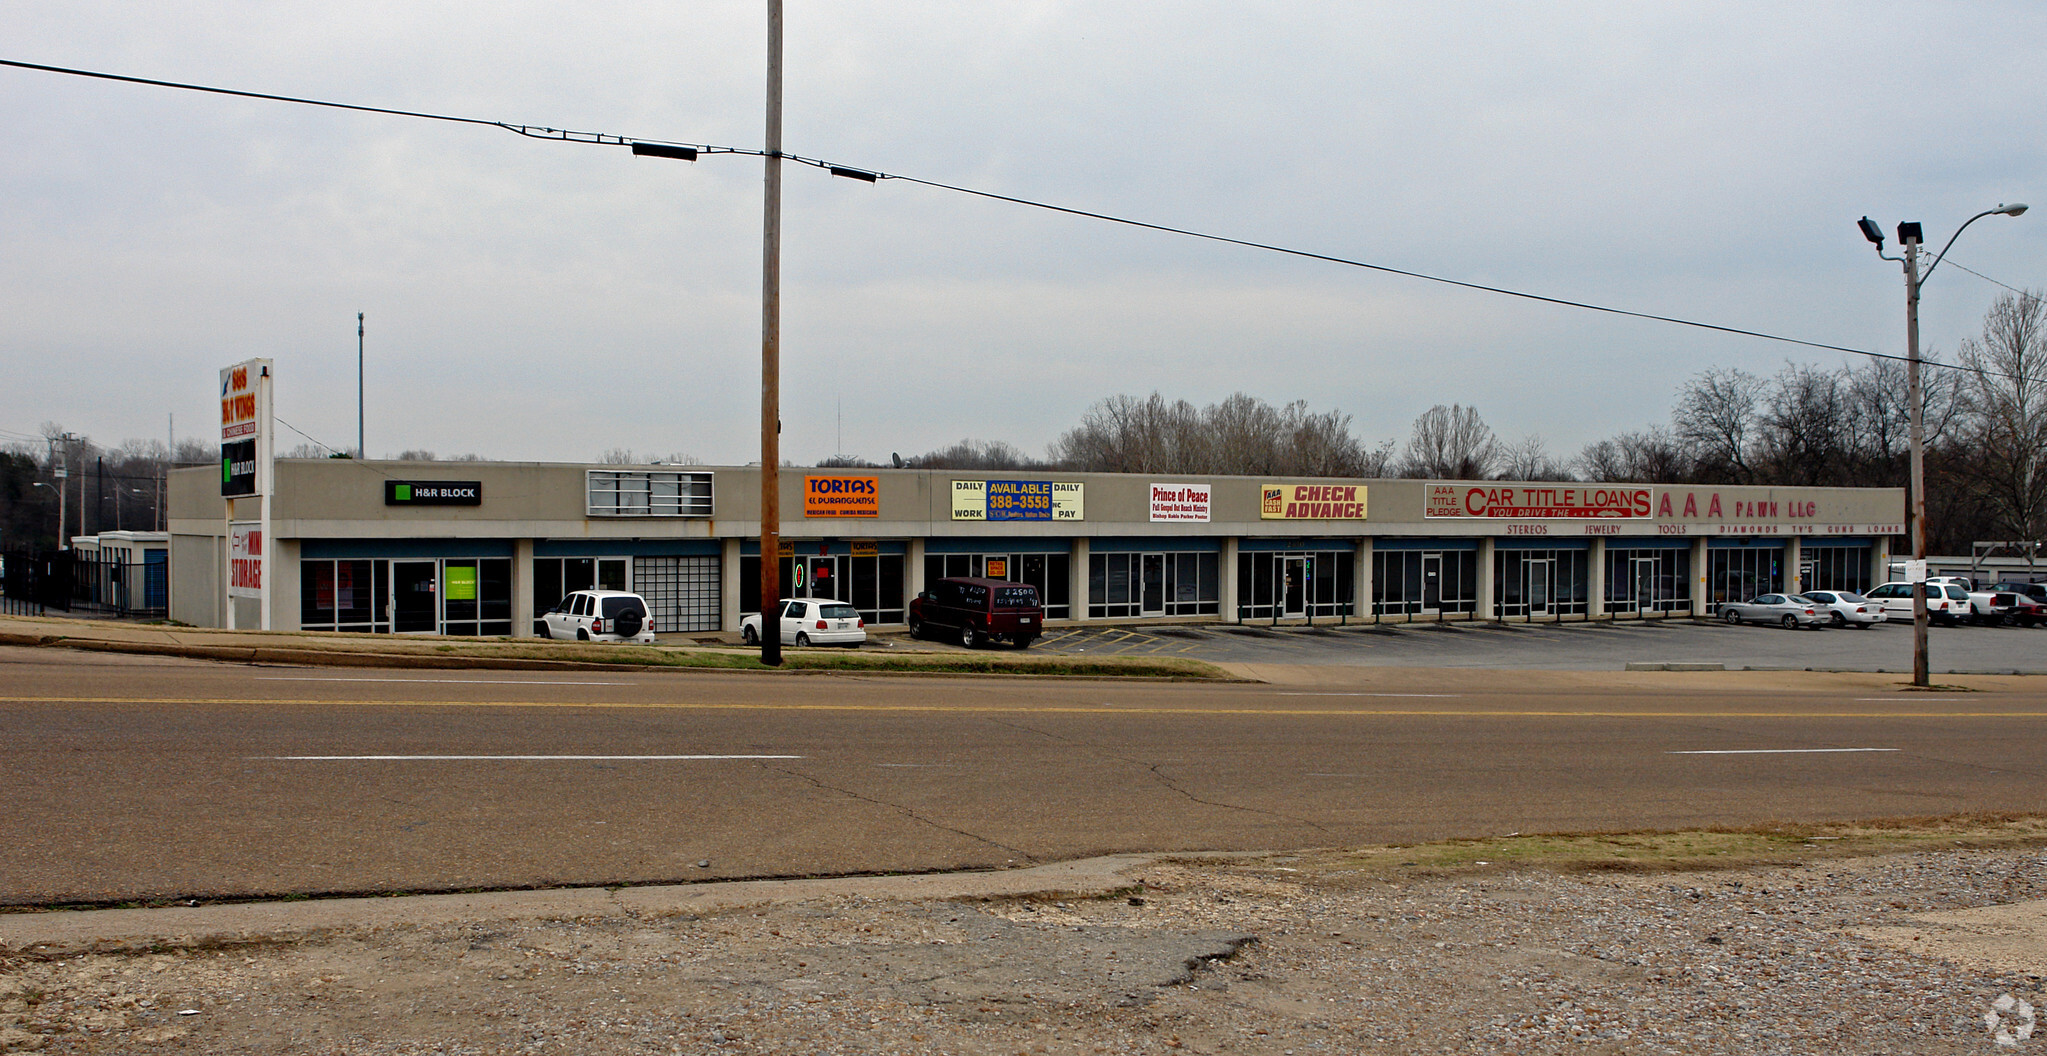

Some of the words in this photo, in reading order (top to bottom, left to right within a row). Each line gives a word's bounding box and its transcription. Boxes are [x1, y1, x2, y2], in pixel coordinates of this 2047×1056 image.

[235, 392, 255, 422] WINGS
[244, 422, 255, 434] FOOD
[241, 459, 255, 474] BLOCK
[810, 479, 875, 494] TORTAS
[956, 482, 983, 491] DAILY
[989, 483, 1050, 495] AVAILABLE
[1054, 484, 1080, 492] DAILY
[1434, 487, 1454, 495] AAA
[415, 488, 438, 498] H&R
[440, 488, 475, 498] BLOCK
[1152, 487, 1176, 501] Prince
[1178, 488, 1186, 502] of
[1187, 488, 1208, 503] Peace
[1266, 489, 1281, 500] AAA
[1294, 486, 1357, 502] CHECK
[818, 497, 876, 505] DURANGUENSE
[989, 495, 1050, 509] 388-3558
[1432, 497, 1457, 506] TITLE
[1465, 488, 1514, 516] CAR
[1522, 489, 1575, 507] TITLE
[1583, 489, 1651, 517] LOANS
[954, 510, 983, 518] WORK
[1285, 502, 1364, 518] ADVANCE
[1426, 508, 1462, 516] PLEDGE
[1493, 508, 1513, 517] YOU
[1518, 508, 1547, 517] DRIVE
[1551, 509, 1570, 517] THE
[1736, 501, 1778, 518] PAWN
[1788, 501, 1816, 518] LLC
[1507, 524, 1548, 535] STEREOS
[1584, 525, 1621, 535] JEWELRY
[1658, 525, 1687, 534] TOOLS
[1828, 525, 1854, 533] GUNS
[1867, 525, 1899, 533] LOANS
[247, 531, 262, 556] MINI
[853, 542, 878, 551] TORTAS
[231, 558, 262, 590] STORAGE
